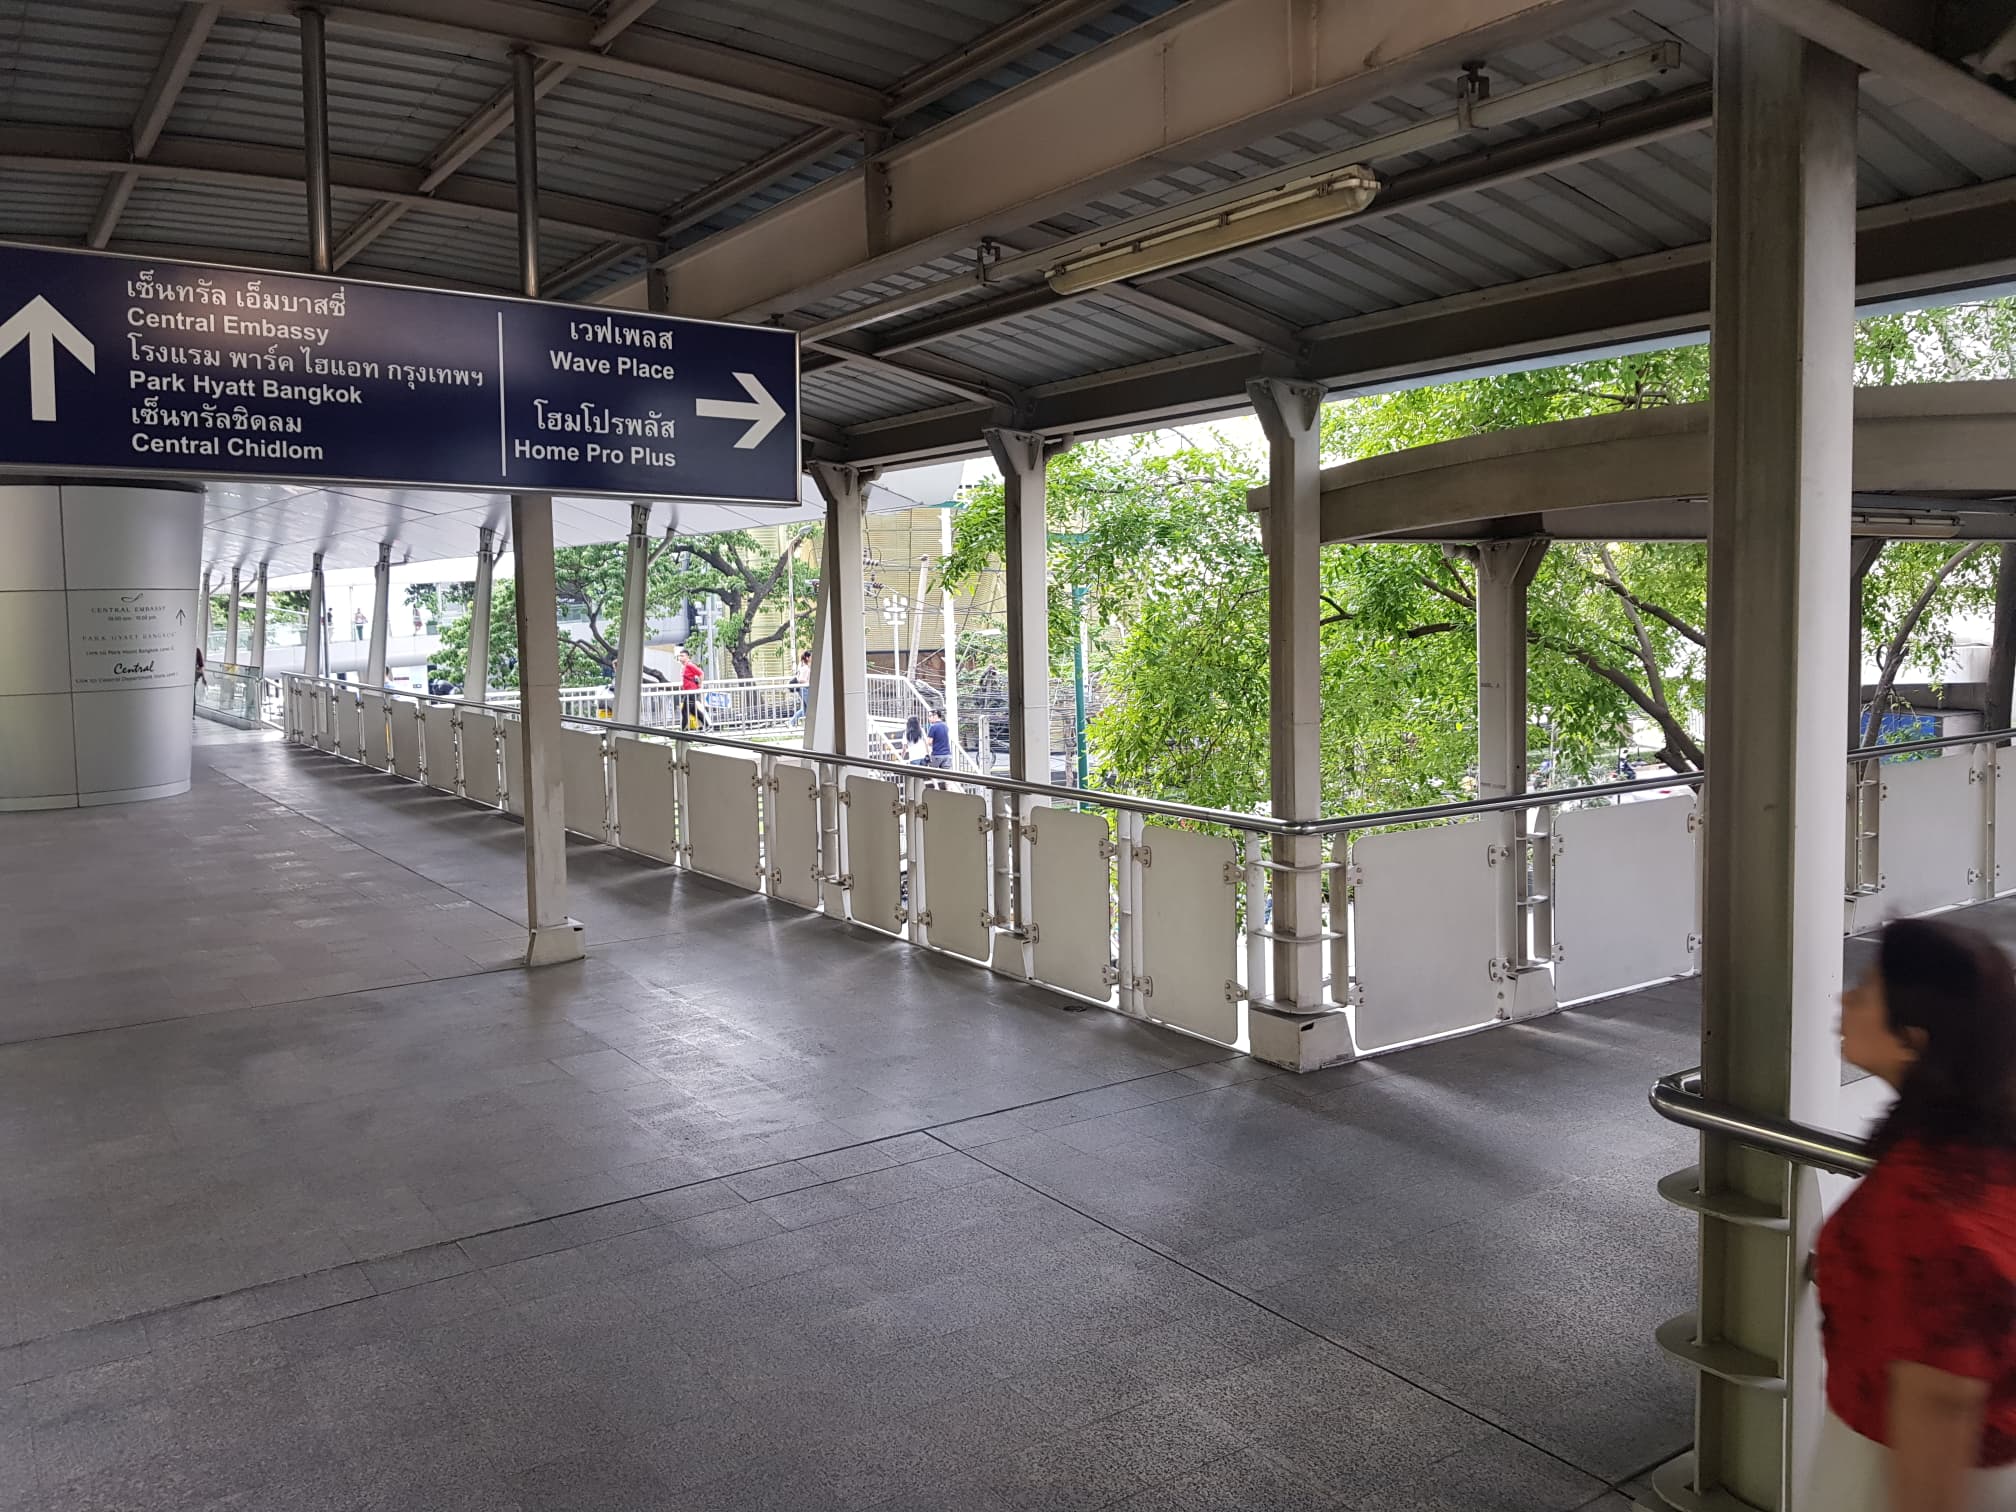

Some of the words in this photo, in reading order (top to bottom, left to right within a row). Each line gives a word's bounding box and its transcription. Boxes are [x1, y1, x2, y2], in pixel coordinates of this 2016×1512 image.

[127, 269, 227, 306] เซ็นทรัล
[236, 280, 347, 317] เอ็มบาสซี่
[127, 307, 215, 333] Central
[223, 314, 330, 345] Embassy
[570, 316, 674, 350] เวฟเพลส
[127, 332, 221, 367] โรงแรม
[228, 343, 294, 372] พาร์ค
[301, 346, 379, 379] ไฮแอท
[387, 364, 483, 390] กรุงเทพฯ
[550, 349, 611, 374] Wave
[618, 356, 675, 380] Place
[130, 370, 186, 392] Park
[193, 374, 256, 399] Hyatt
[263, 379, 362, 404] Bangkok
[131, 396, 303, 433] เซ็นทรัลชิดลม
[533, 398, 676, 439] โฮมโปรพลัส
[131, 433, 219, 456] Central
[227, 438, 324, 460] Chidlom
[514, 438, 580, 462] Home
[587, 443, 623, 464] Pro
[630, 446, 676, 467] Plus
[113, 660, 154, 675] Central
